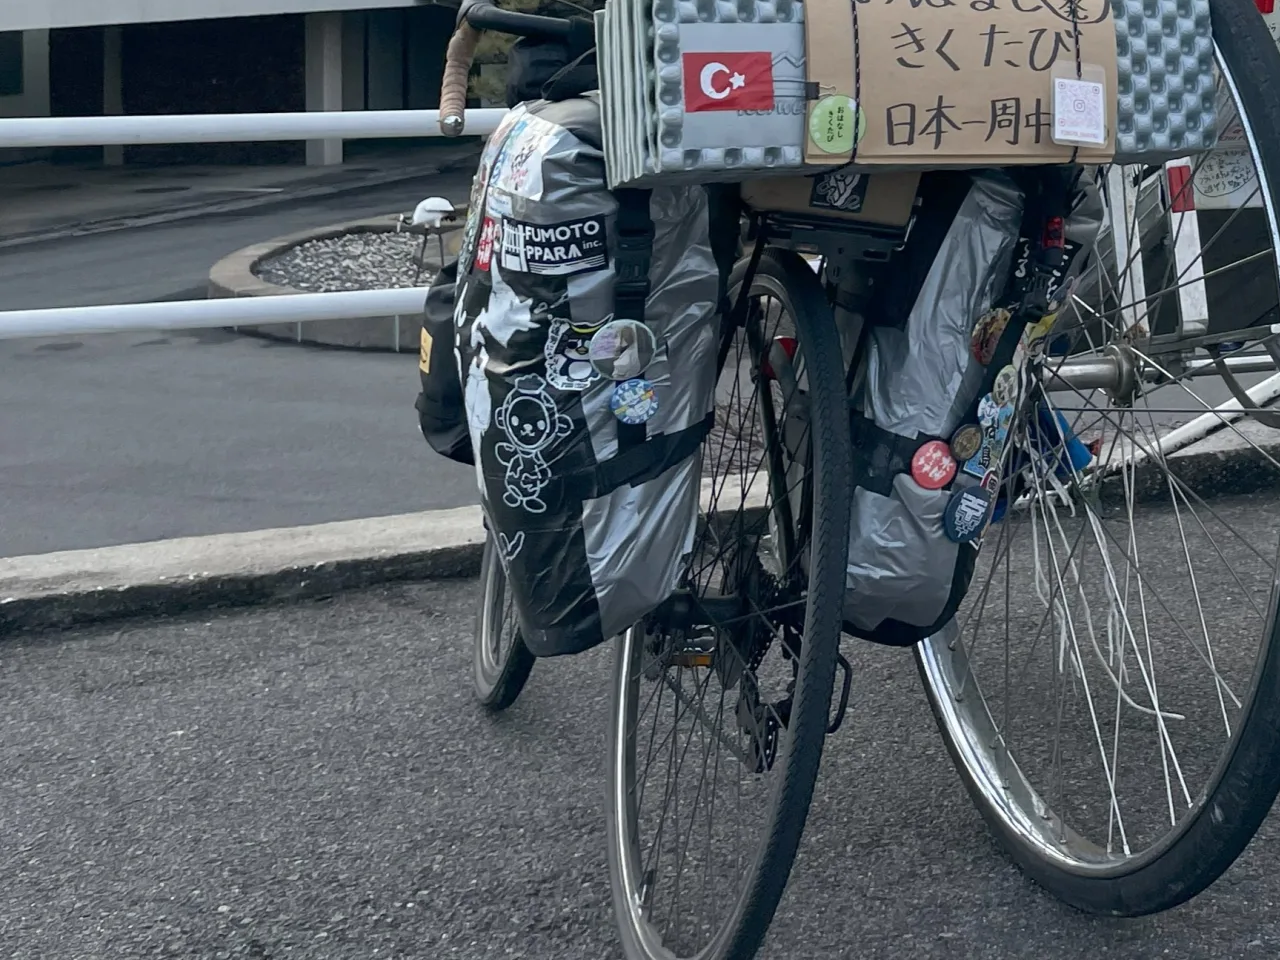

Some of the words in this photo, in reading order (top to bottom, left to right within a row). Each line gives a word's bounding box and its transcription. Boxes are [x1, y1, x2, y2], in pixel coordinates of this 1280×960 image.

[891, 22, 1084, 72] きくたび
[826, 110, 835, 143] きくたび
[837, 106, 845, 139] おはなし
[887, 95, 1054, 150] 日本一周中
[525, 220, 600, 243] FUMOTO
[526, 243, 582, 262] PPARA
[582, 240, 603, 251] inc.
